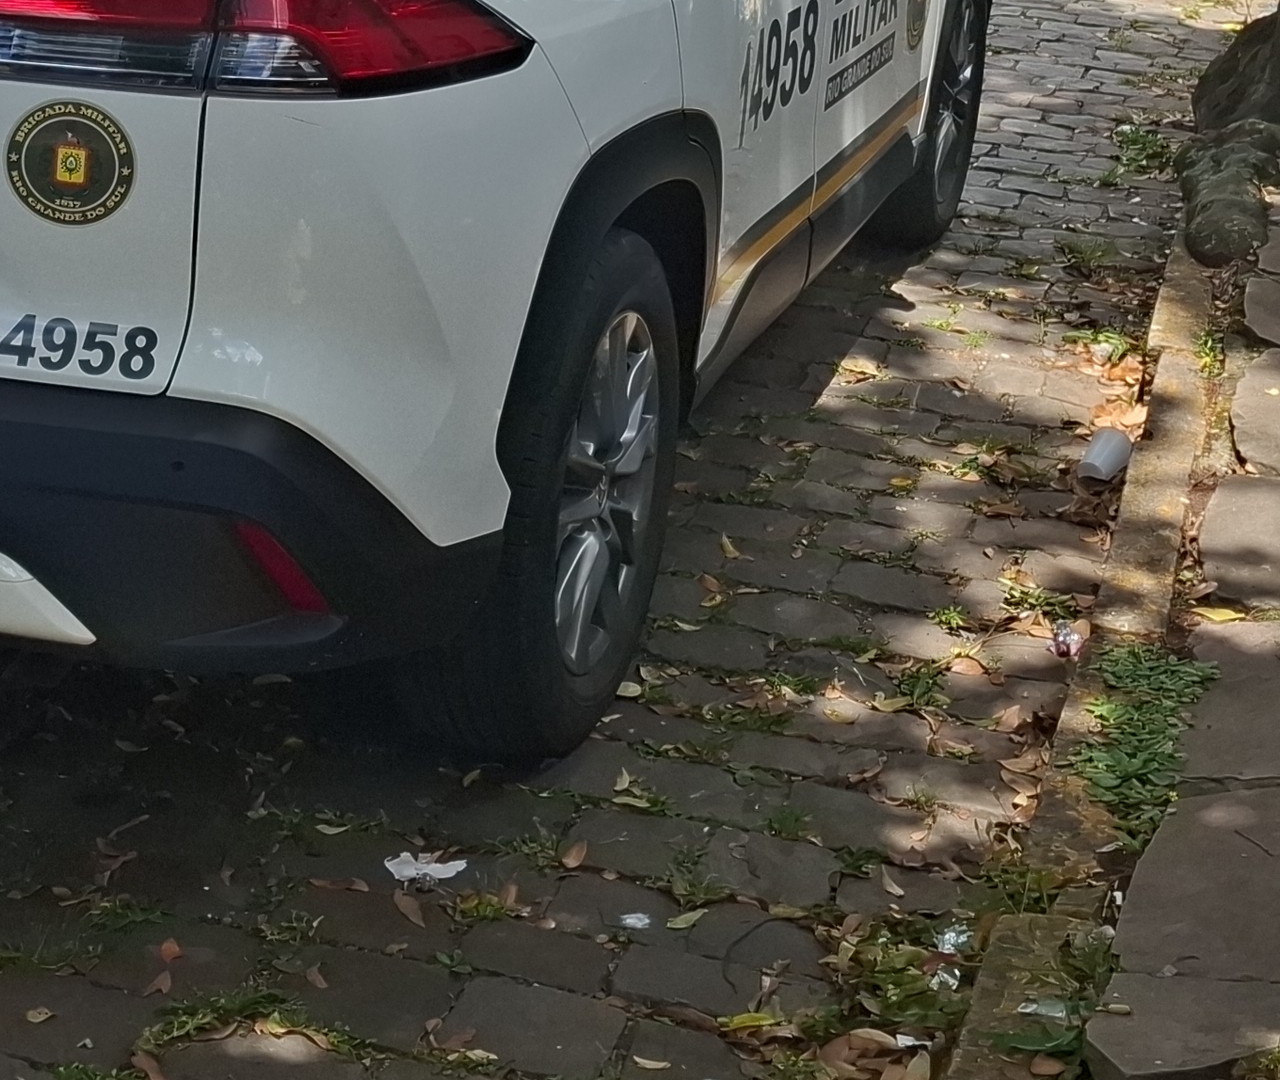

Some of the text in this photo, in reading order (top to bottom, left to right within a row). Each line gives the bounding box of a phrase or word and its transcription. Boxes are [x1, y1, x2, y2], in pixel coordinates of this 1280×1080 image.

[825, 76, 841, 104] RIO
[14, 104, 128, 156] BRIGADA MILITAR
[10, 170, 127, 221] RIO GRANDE DO SUL
